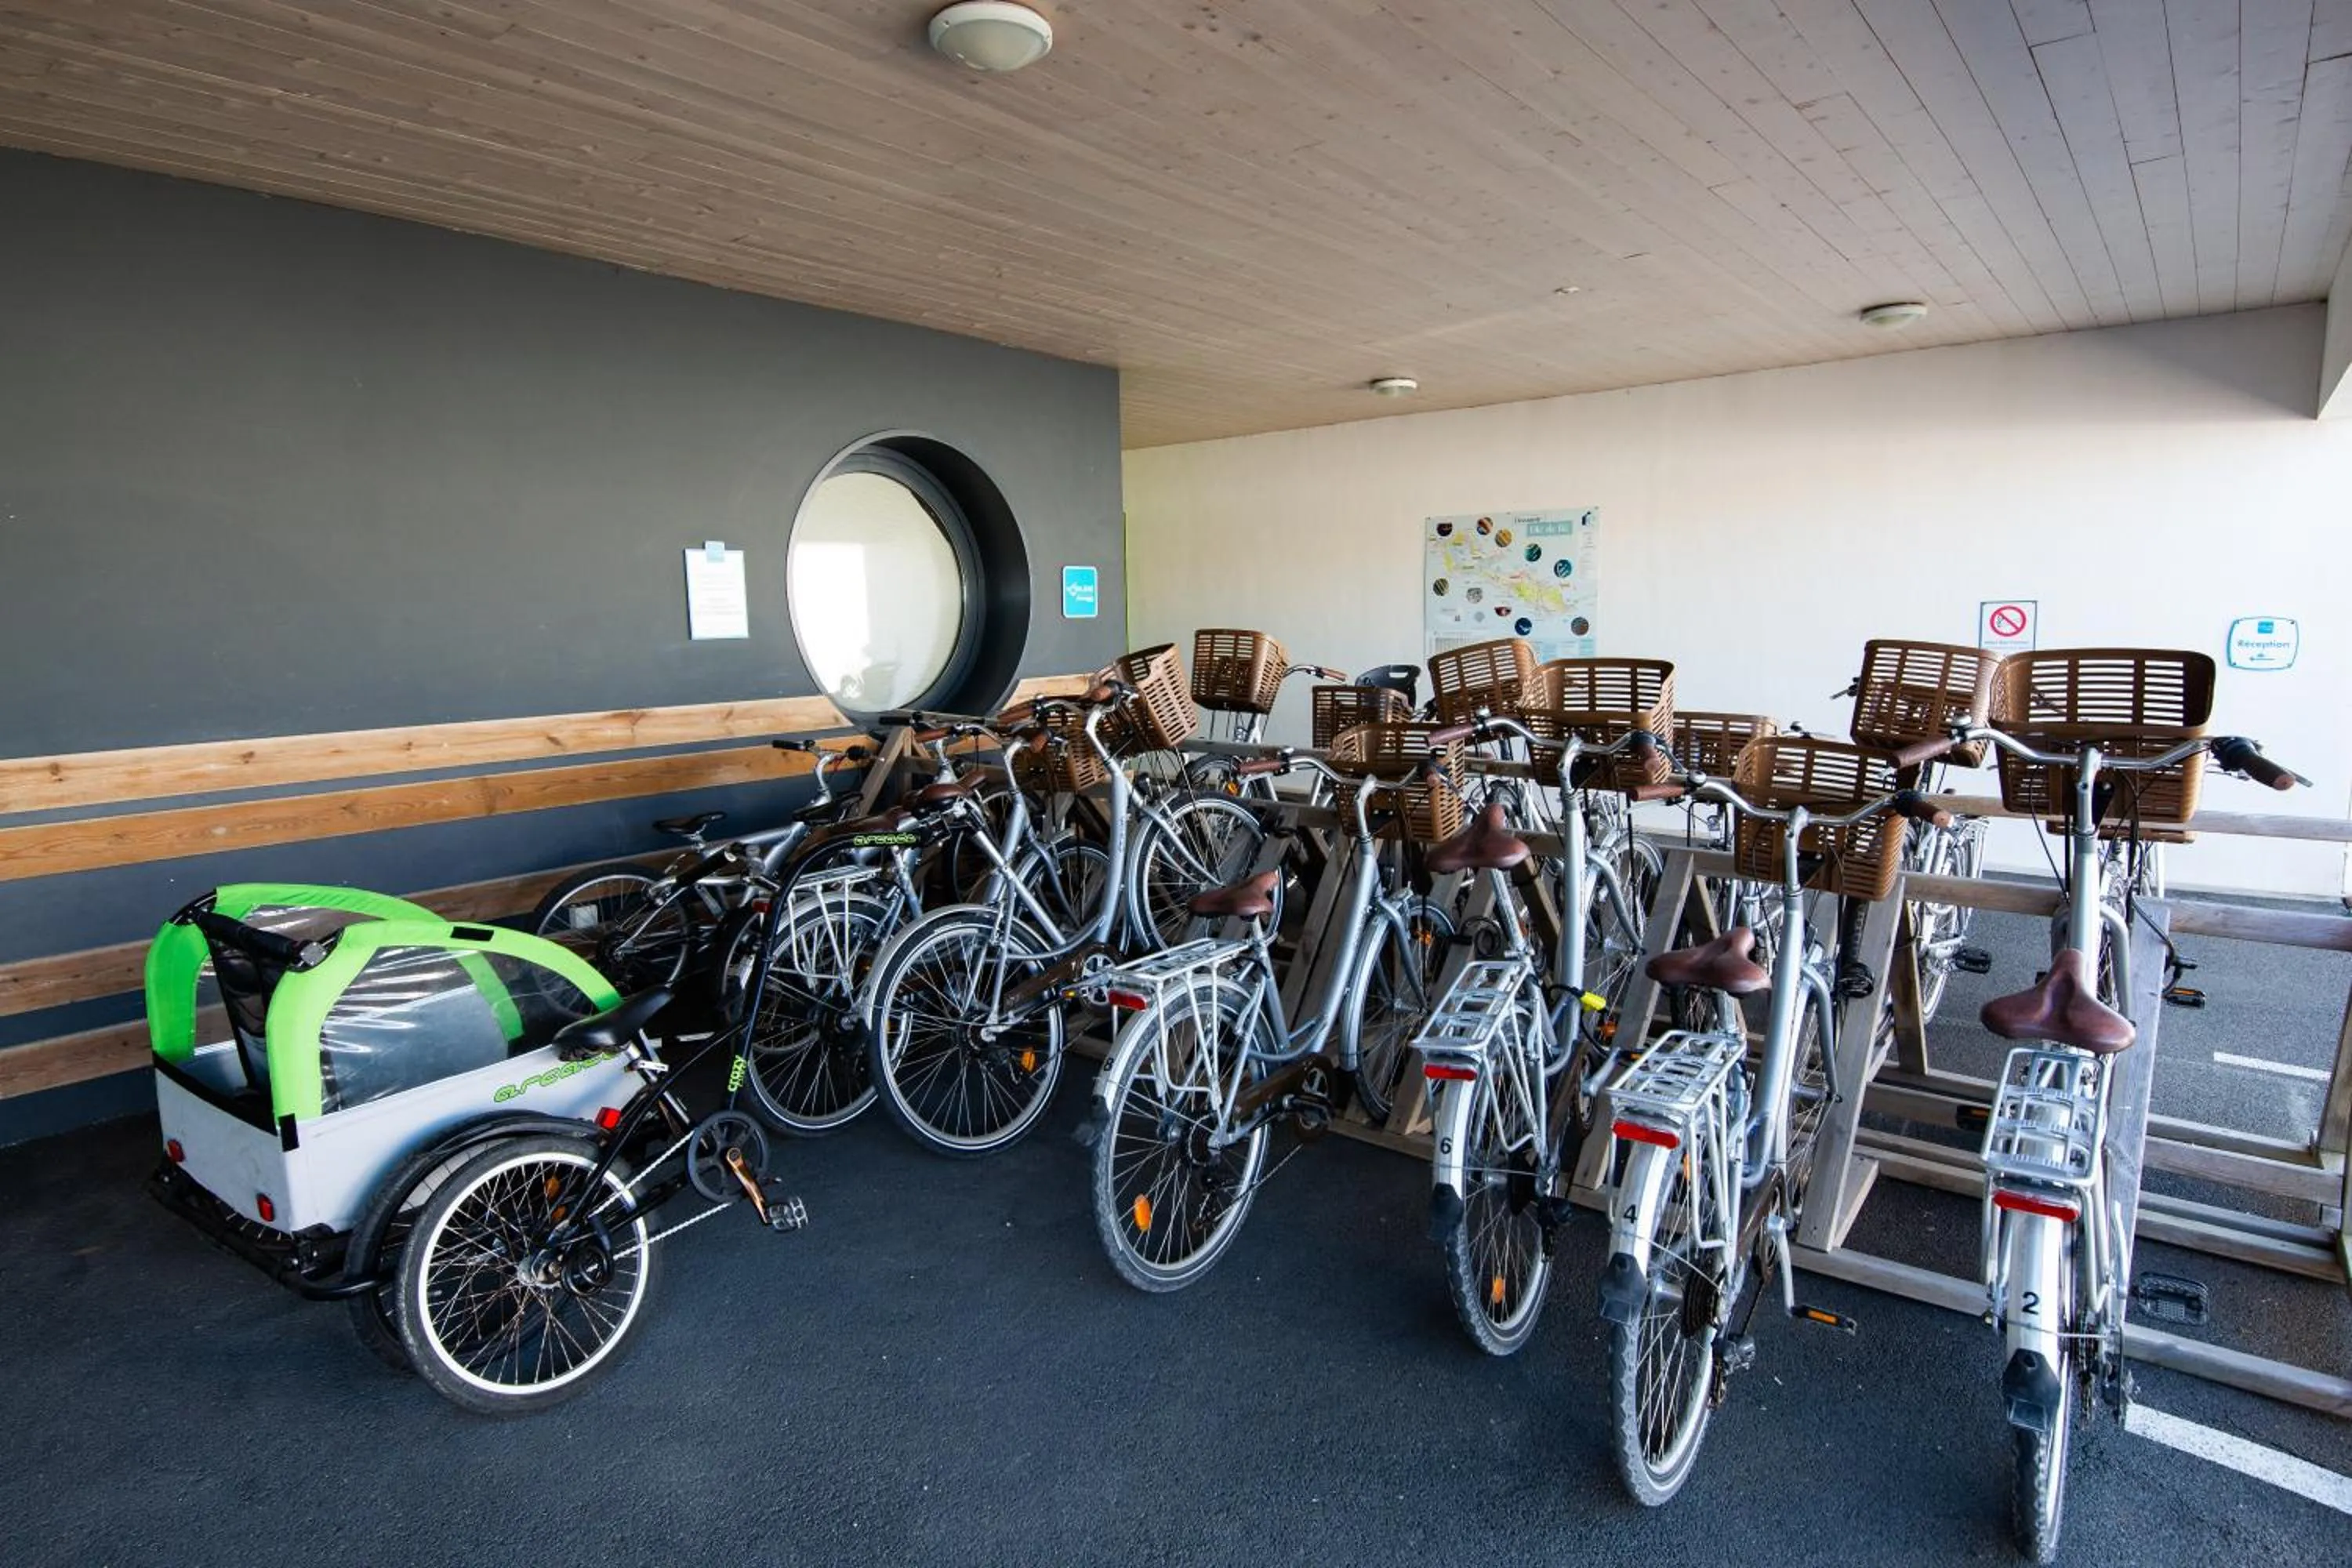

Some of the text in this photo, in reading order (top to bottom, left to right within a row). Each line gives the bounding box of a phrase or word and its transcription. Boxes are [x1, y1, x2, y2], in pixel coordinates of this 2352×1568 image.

[2238, 639, 2289, 649] Réception
[1104, 1058, 1114, 1071] 8
[1440, 1138, 1452, 1154] 6
[1624, 1204, 1637, 1224] 4
[2022, 1291, 2039, 1315] 2
